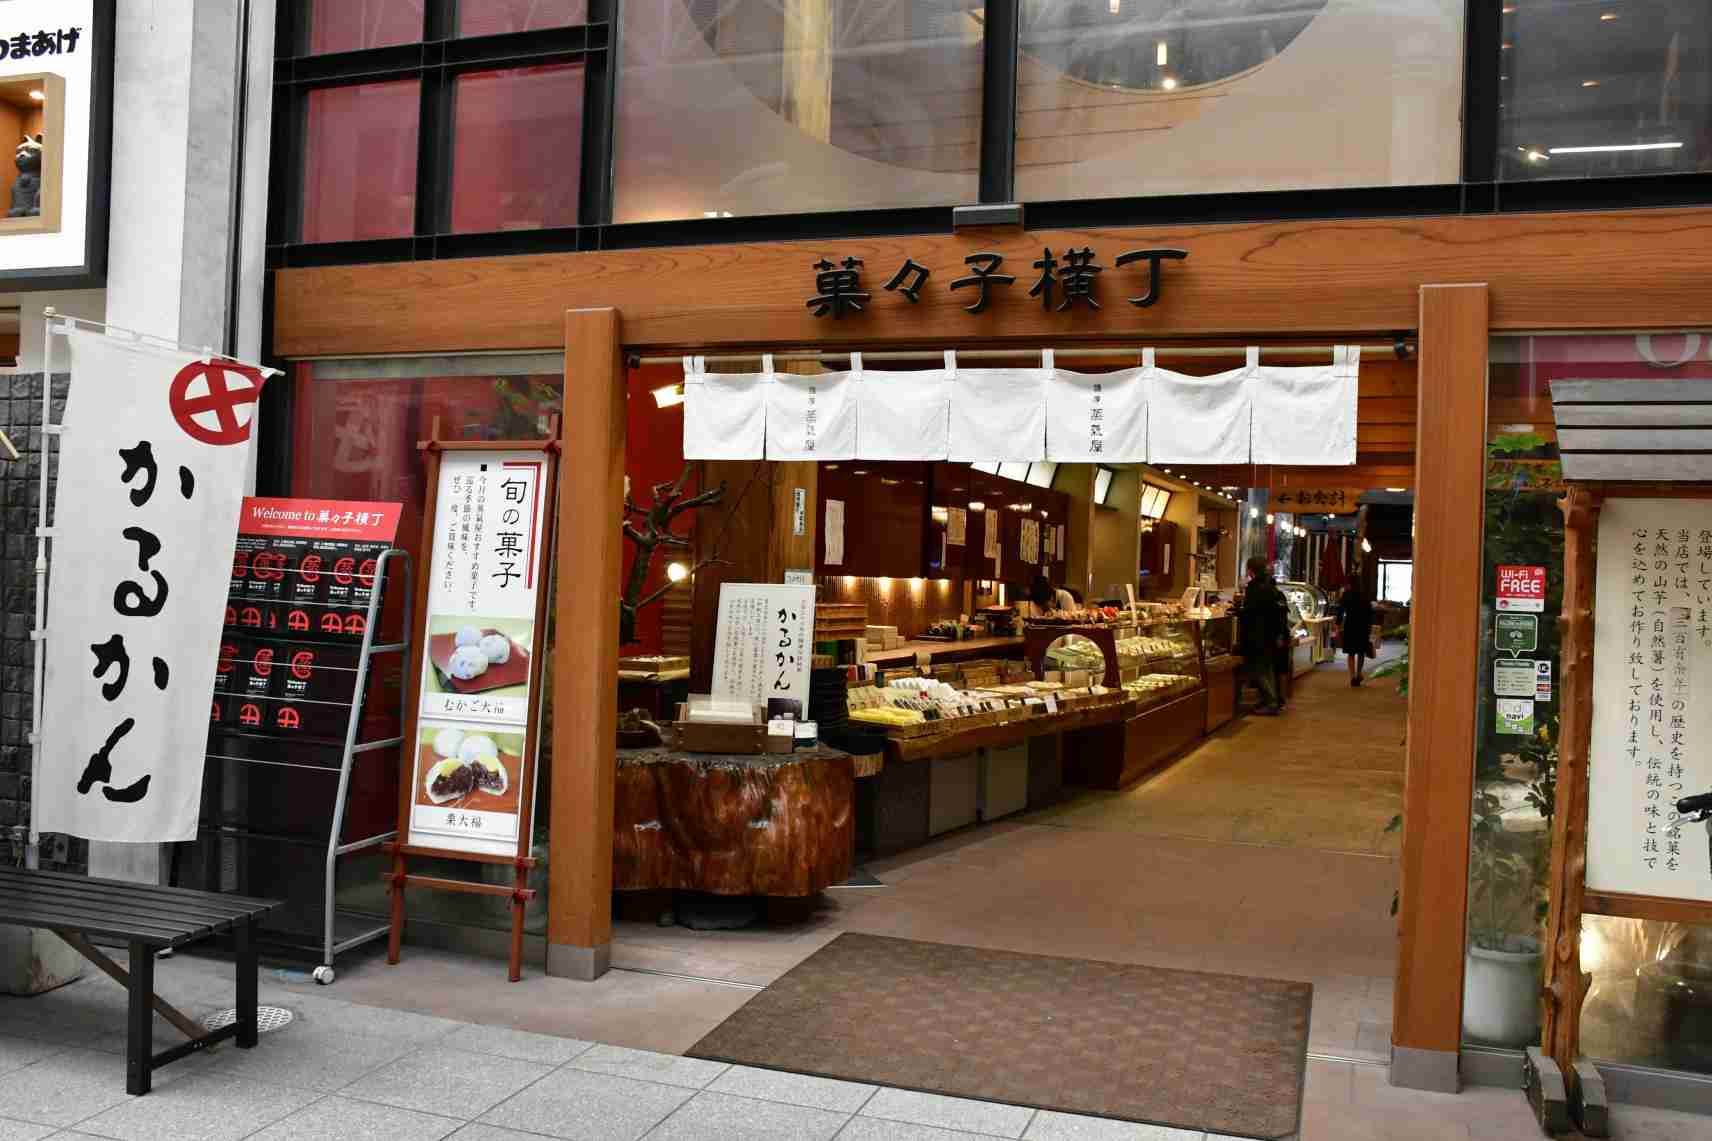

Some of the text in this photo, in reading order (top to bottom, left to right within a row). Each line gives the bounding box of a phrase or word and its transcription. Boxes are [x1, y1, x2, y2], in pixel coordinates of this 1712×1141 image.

[806, 247, 1189, 318] 菓々子横丁
[252, 506, 302, 521] Welcome
[304, 510, 316, 521] to
[491, 477, 528, 588] 旬の菓子
[77, 440, 195, 803] かるかん
[1501, 579, 1541, 592] FREE
[774, 607, 797, 690] かるかん
